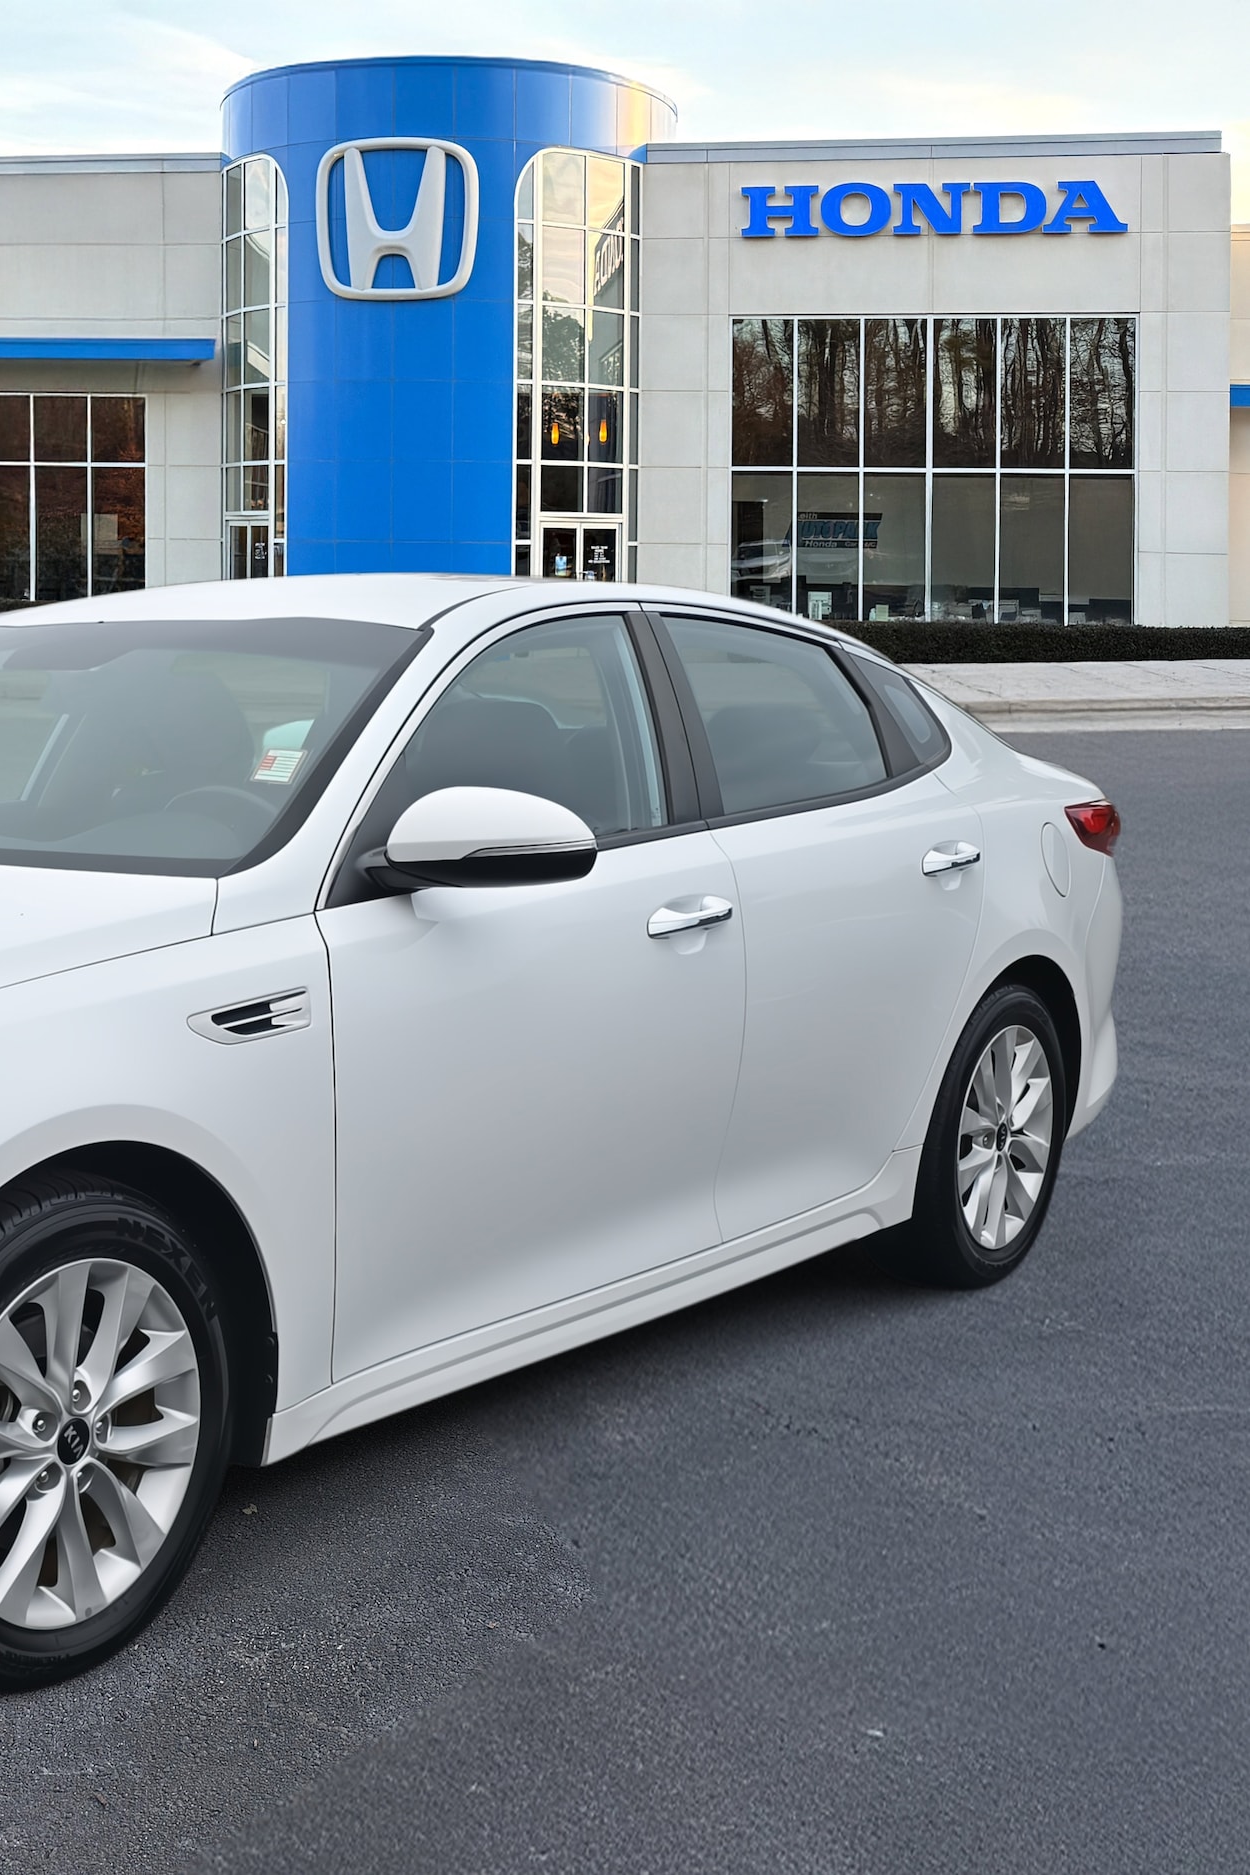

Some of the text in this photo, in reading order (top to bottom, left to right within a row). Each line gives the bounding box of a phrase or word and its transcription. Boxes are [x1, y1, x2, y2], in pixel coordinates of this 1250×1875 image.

[741, 180, 1129, 237] HONDA
[797, 512, 818, 520] eith
[804, 540, 838, 548] Honda
[116, 1217, 218, 1322] NEXEN
[63, 1424, 84, 1460] KIA
